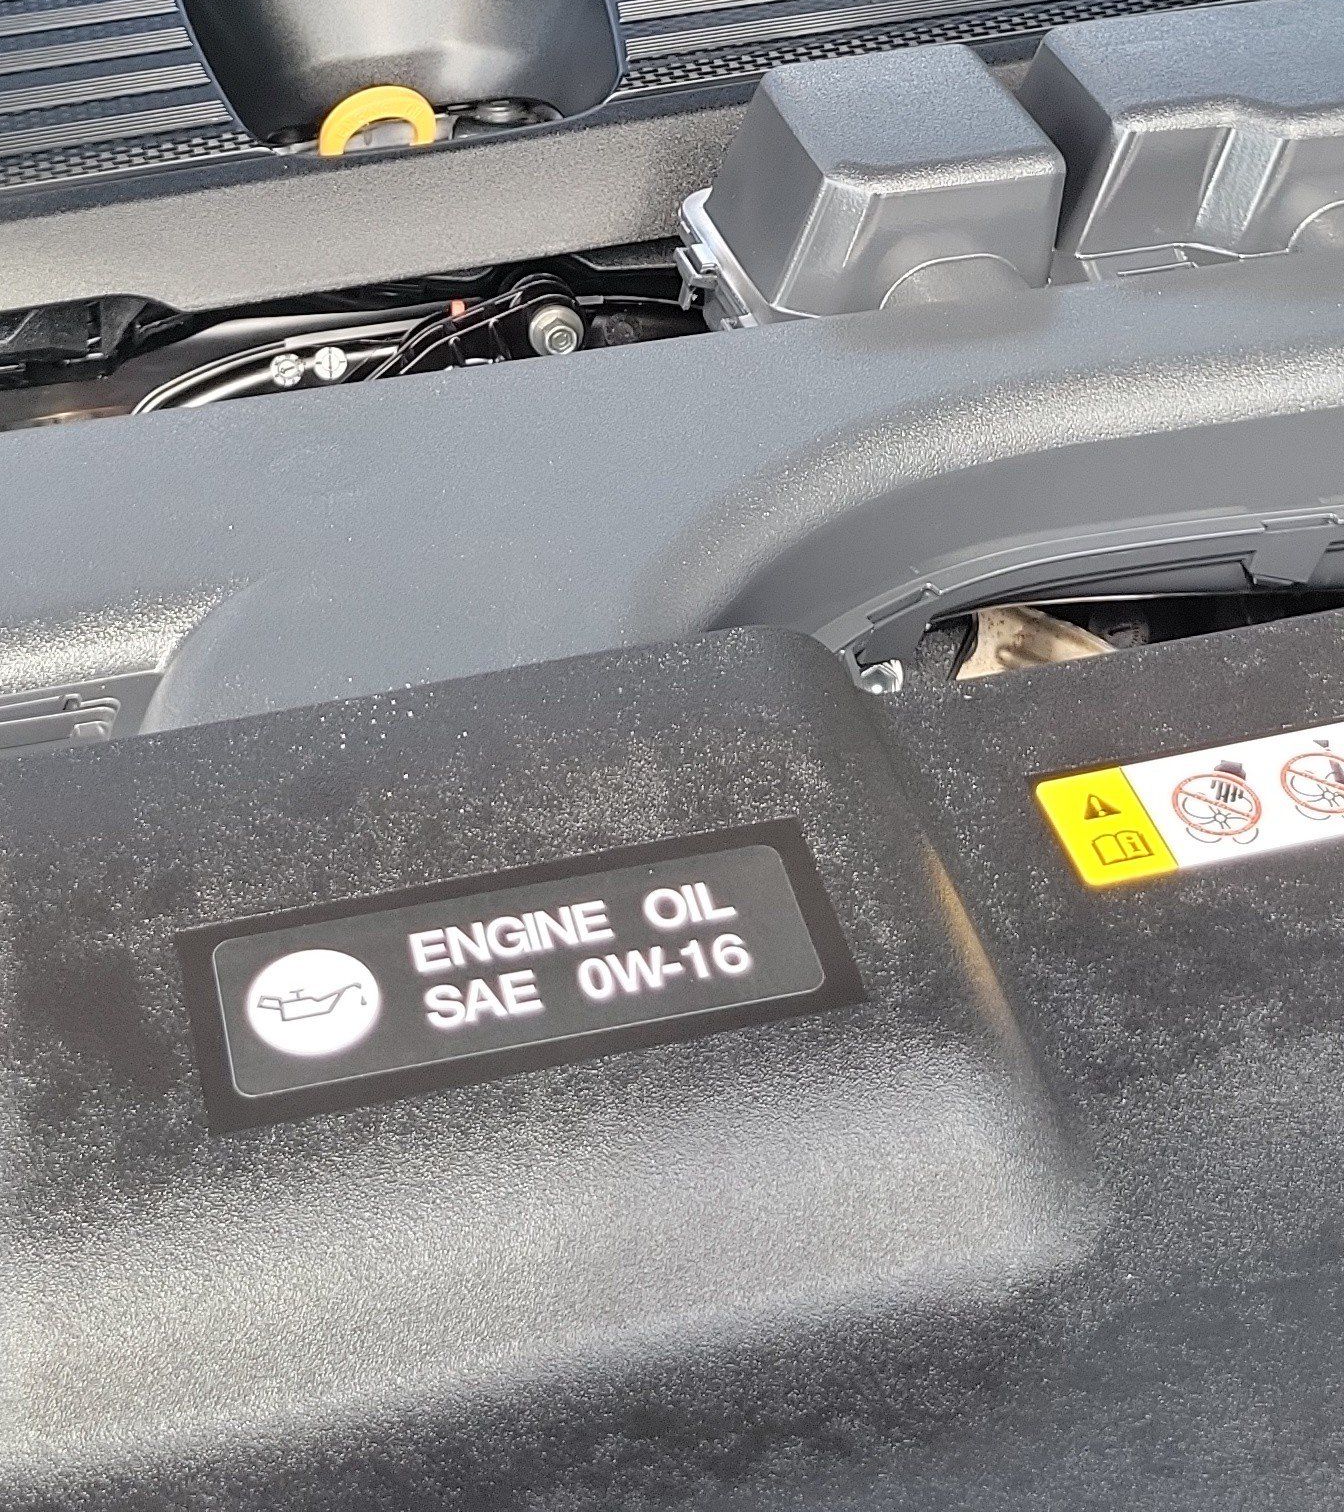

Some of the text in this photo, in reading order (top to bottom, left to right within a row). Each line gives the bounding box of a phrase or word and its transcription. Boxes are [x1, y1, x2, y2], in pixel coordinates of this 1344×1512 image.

[408, 881, 737, 974] ENGINE OIL
[423, 932, 753, 1029] SAE 0W-16
